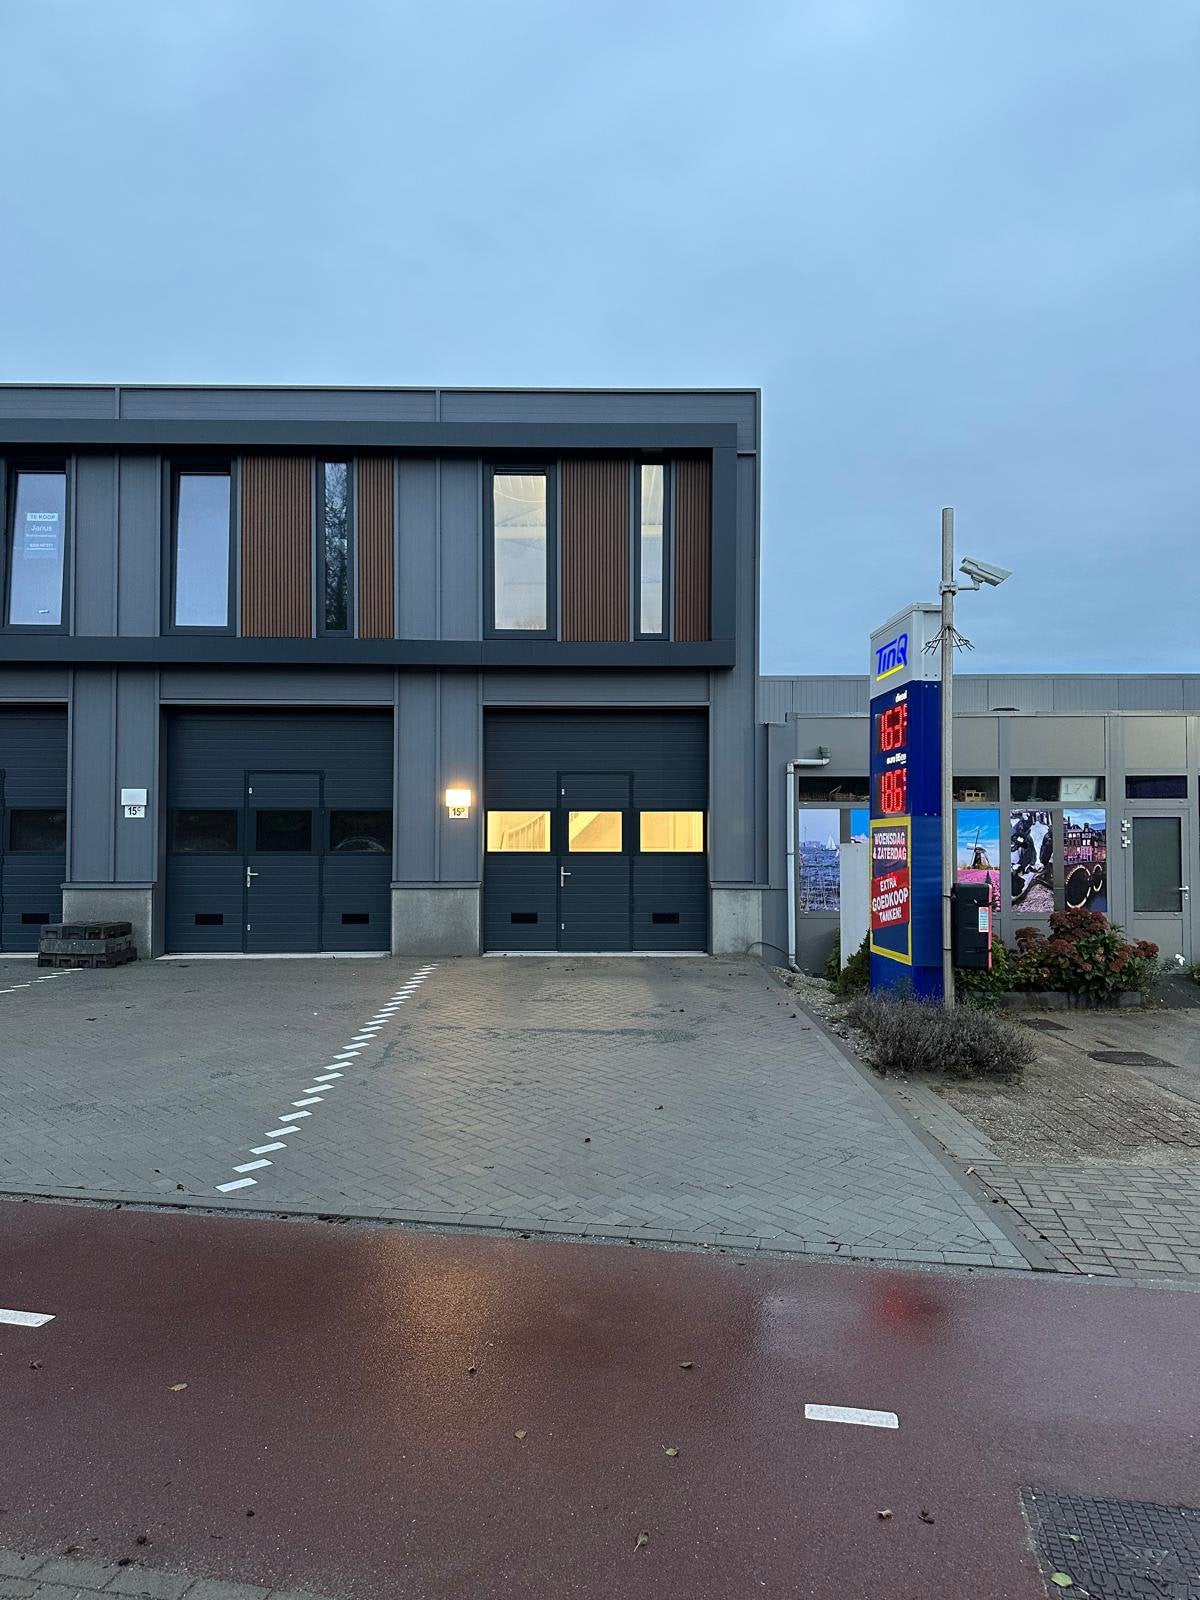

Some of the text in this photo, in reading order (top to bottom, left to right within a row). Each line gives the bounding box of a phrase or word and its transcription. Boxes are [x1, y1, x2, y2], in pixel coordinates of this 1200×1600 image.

[873, 832, 906, 846] WOENSDAG
[877, 847, 907, 860] ZATERDAG
[880, 878, 897, 892] EXTRA
[872, 887, 909, 912] GOEDKOOP
